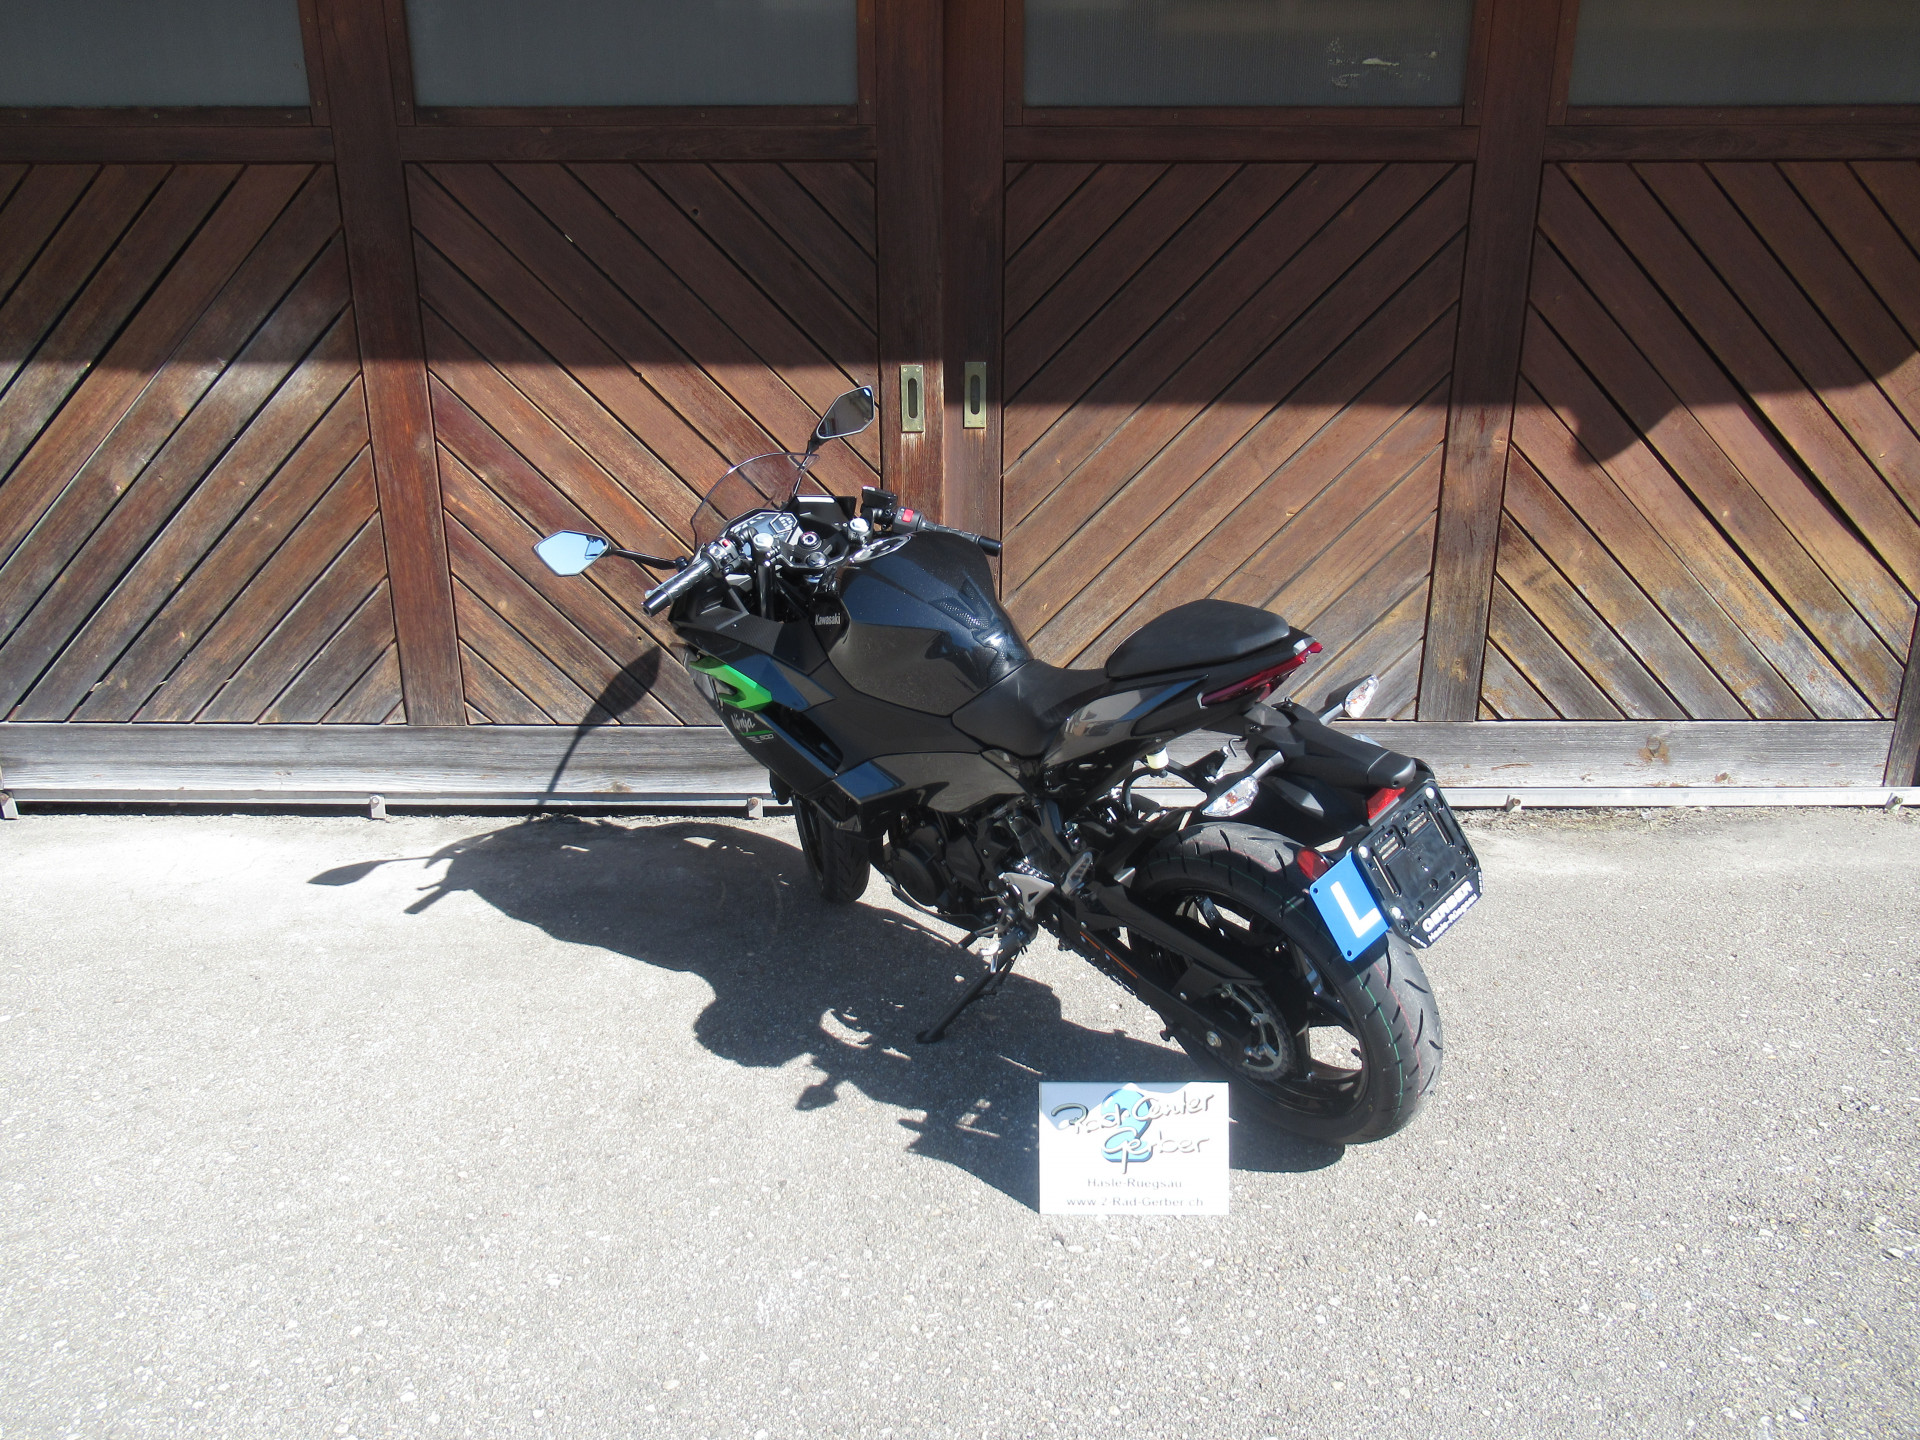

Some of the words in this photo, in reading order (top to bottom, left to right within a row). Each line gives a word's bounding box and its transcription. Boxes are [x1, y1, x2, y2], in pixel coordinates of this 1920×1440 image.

[814, 613, 841, 626] Kawasaki
[730, 712, 756, 733] Ninja
[1330, 881, 1382, 938] L
[1422, 880, 1474, 933] GERBER
[1103, 1127, 1210, 1175] Gerber
[1066, 1196, 1204, 1207] www2-Rad-Gerberch
